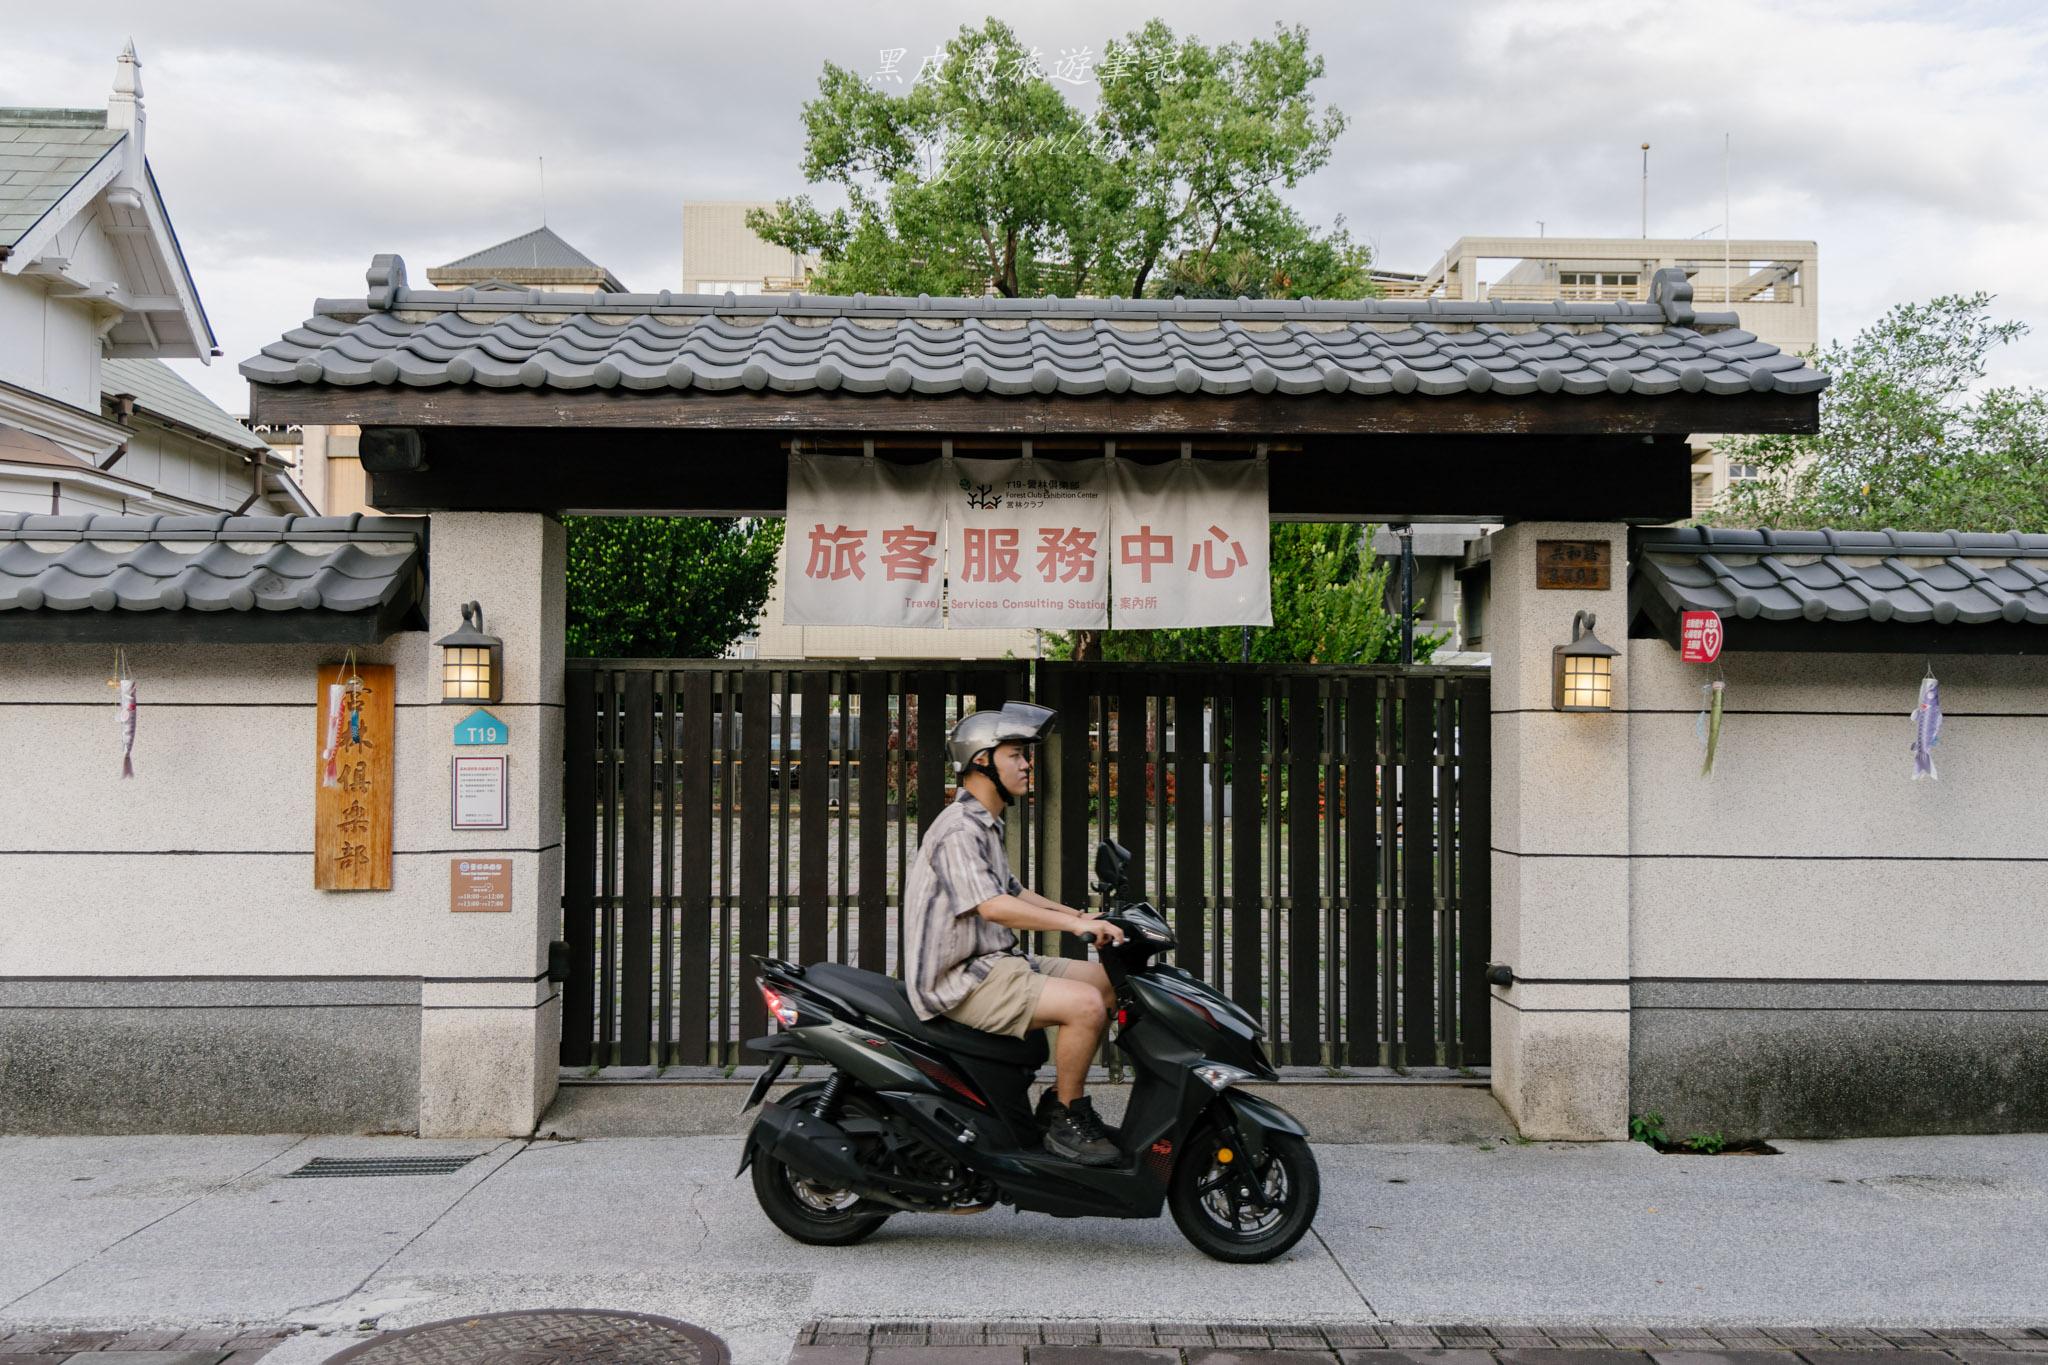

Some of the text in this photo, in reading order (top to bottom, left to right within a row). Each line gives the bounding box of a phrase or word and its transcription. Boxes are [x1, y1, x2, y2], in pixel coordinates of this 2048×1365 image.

[1027, 491, 1043, 499] Club
[904, 597, 940, 608] Travel
[951, 599, 998, 609] Services
[1002, 599, 1064, 609] Consulting
[1067, 599, 1106, 609] Station
[467, 727, 497, 742] T19
